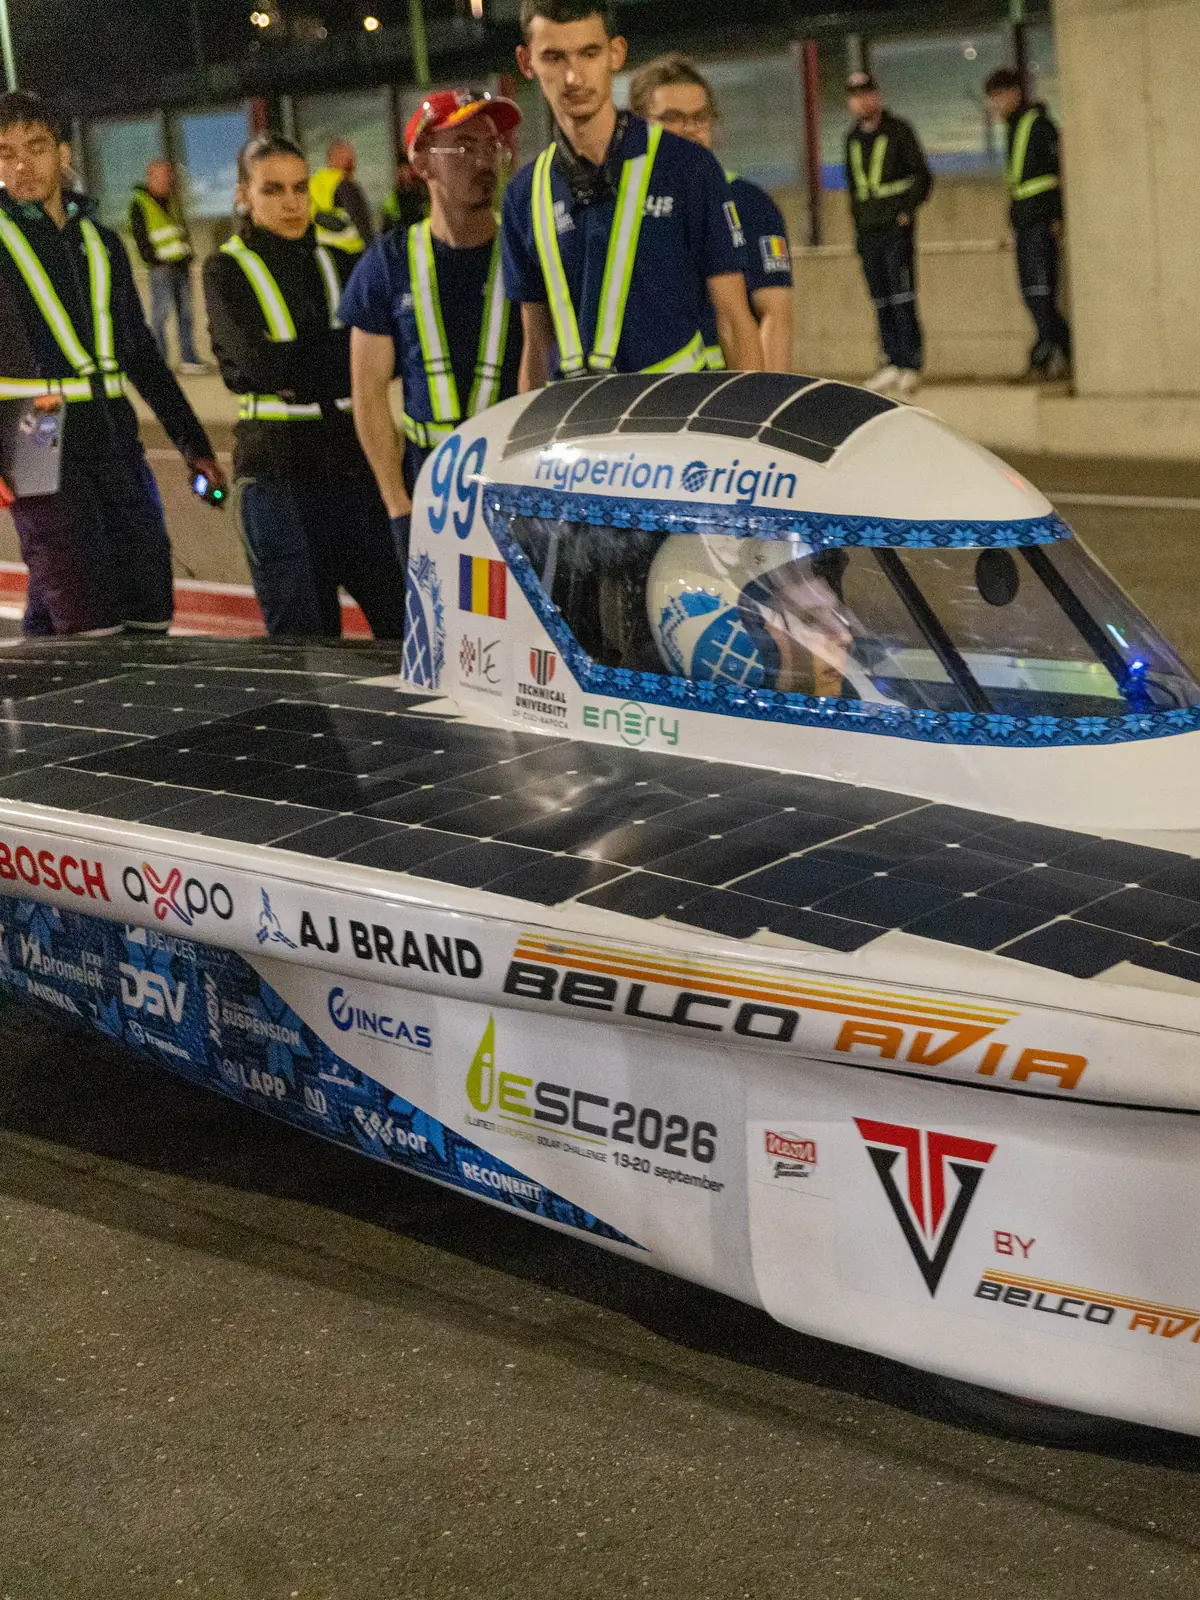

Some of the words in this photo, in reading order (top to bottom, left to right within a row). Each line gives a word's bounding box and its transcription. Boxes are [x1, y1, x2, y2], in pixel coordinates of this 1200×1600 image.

[427, 434, 489, 540] 99
[515, 695, 568, 718] UNIVERSITY
[518, 682, 567, 704] TECHNICAL
[0, 844, 111, 902] BOSCH
[122, 861, 234, 926] axpo
[300, 911, 340, 954] AJ
[349, 921, 482, 979] BRAND
[119, 961, 187, 1025] DSV
[221, 1008, 300, 1047] SUSPENSION
[356, 1008, 432, 1048] INCAS
[503, 961, 800, 1044] BELCO
[834, 1018, 1089, 1090] AVIA
[240, 1064, 288, 1099] LAPP
[461, 1161, 542, 1202] RECONBATT
[612, 1150, 651, 1174] 19-20
[653, 1166, 725, 1193] september
[993, 1230, 1035, 1259] BY
[974, 1280, 1116, 1326] BELCO
